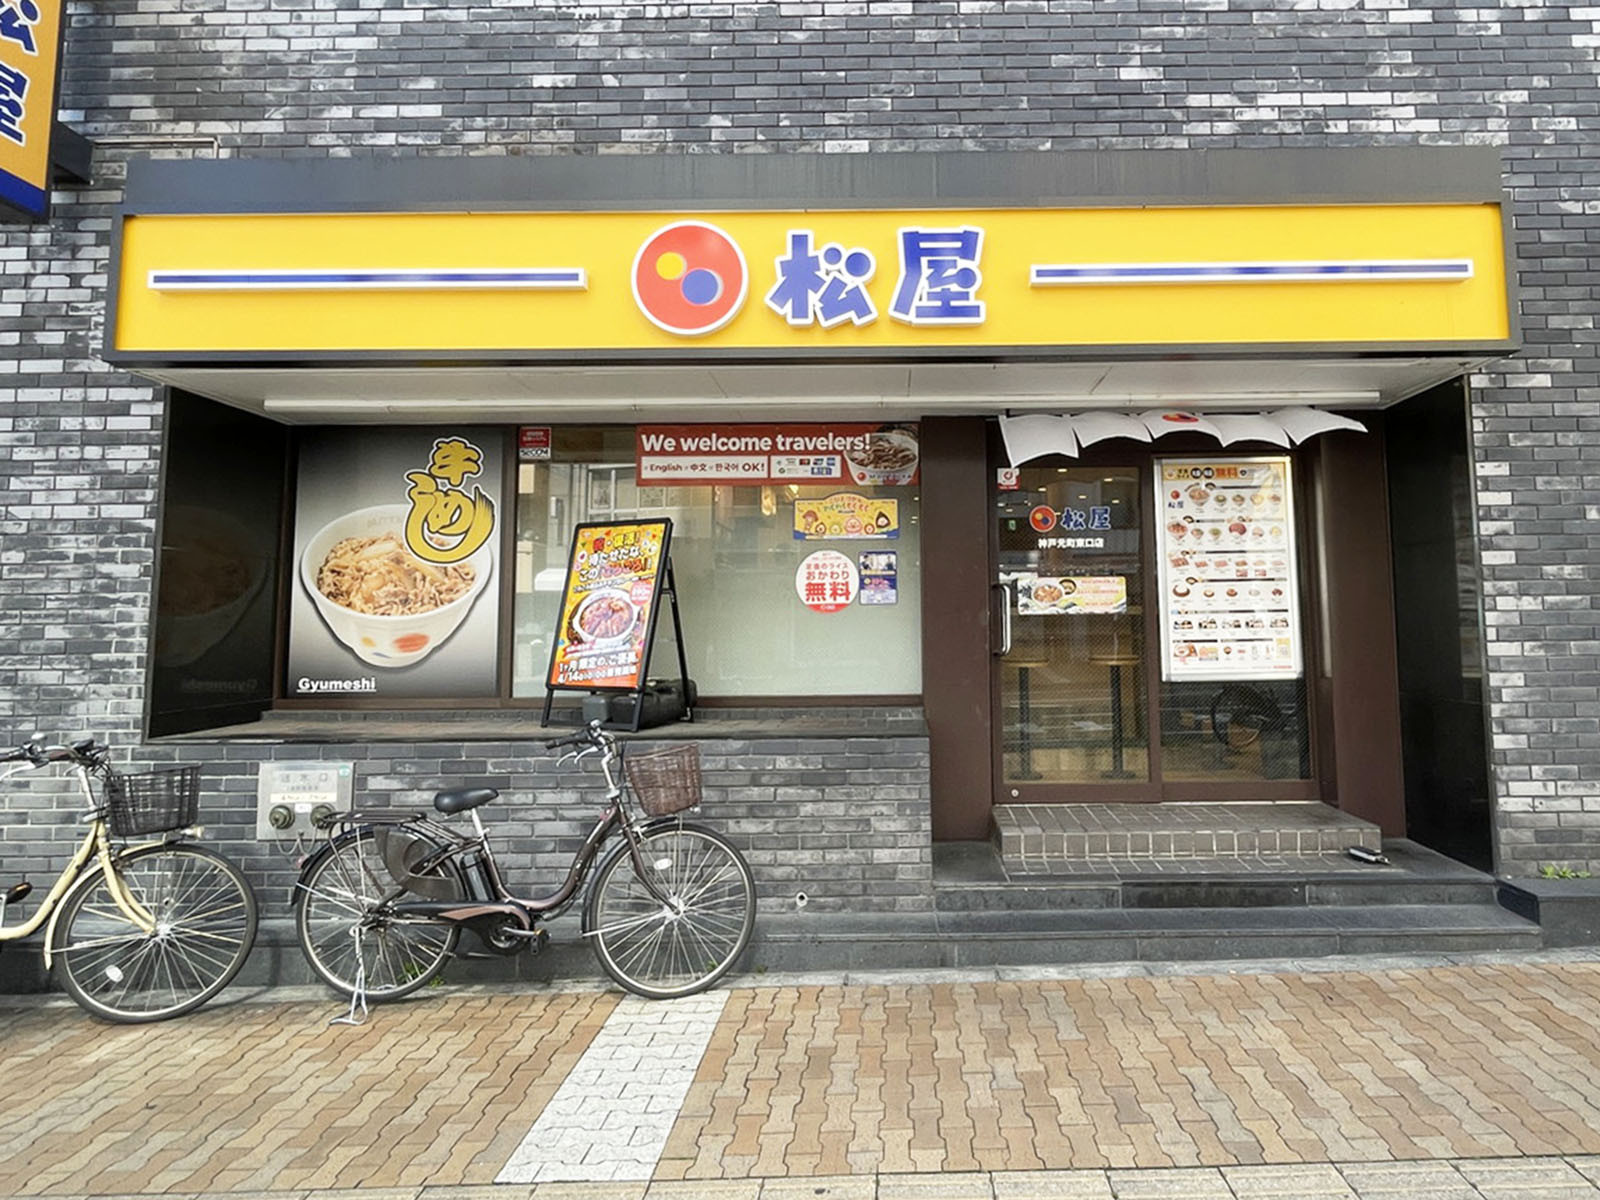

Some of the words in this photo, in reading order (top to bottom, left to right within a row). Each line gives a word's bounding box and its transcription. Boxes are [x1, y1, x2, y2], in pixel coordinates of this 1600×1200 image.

[764, 226, 987, 329] 松屋
[641, 434, 676, 452] We
[680, 432, 772, 452] welcome
[776, 432, 870, 451] travelers!
[650, 463, 682, 473] English
[690, 463, 706, 472] 中文
[742, 462, 765, 472] OK!
[1060, 506, 1111, 530] 松屋
[806, 571, 850, 580] おかわり
[805, 581, 851, 602] 無料
[298, 677, 376, 692] Gyumeshi
